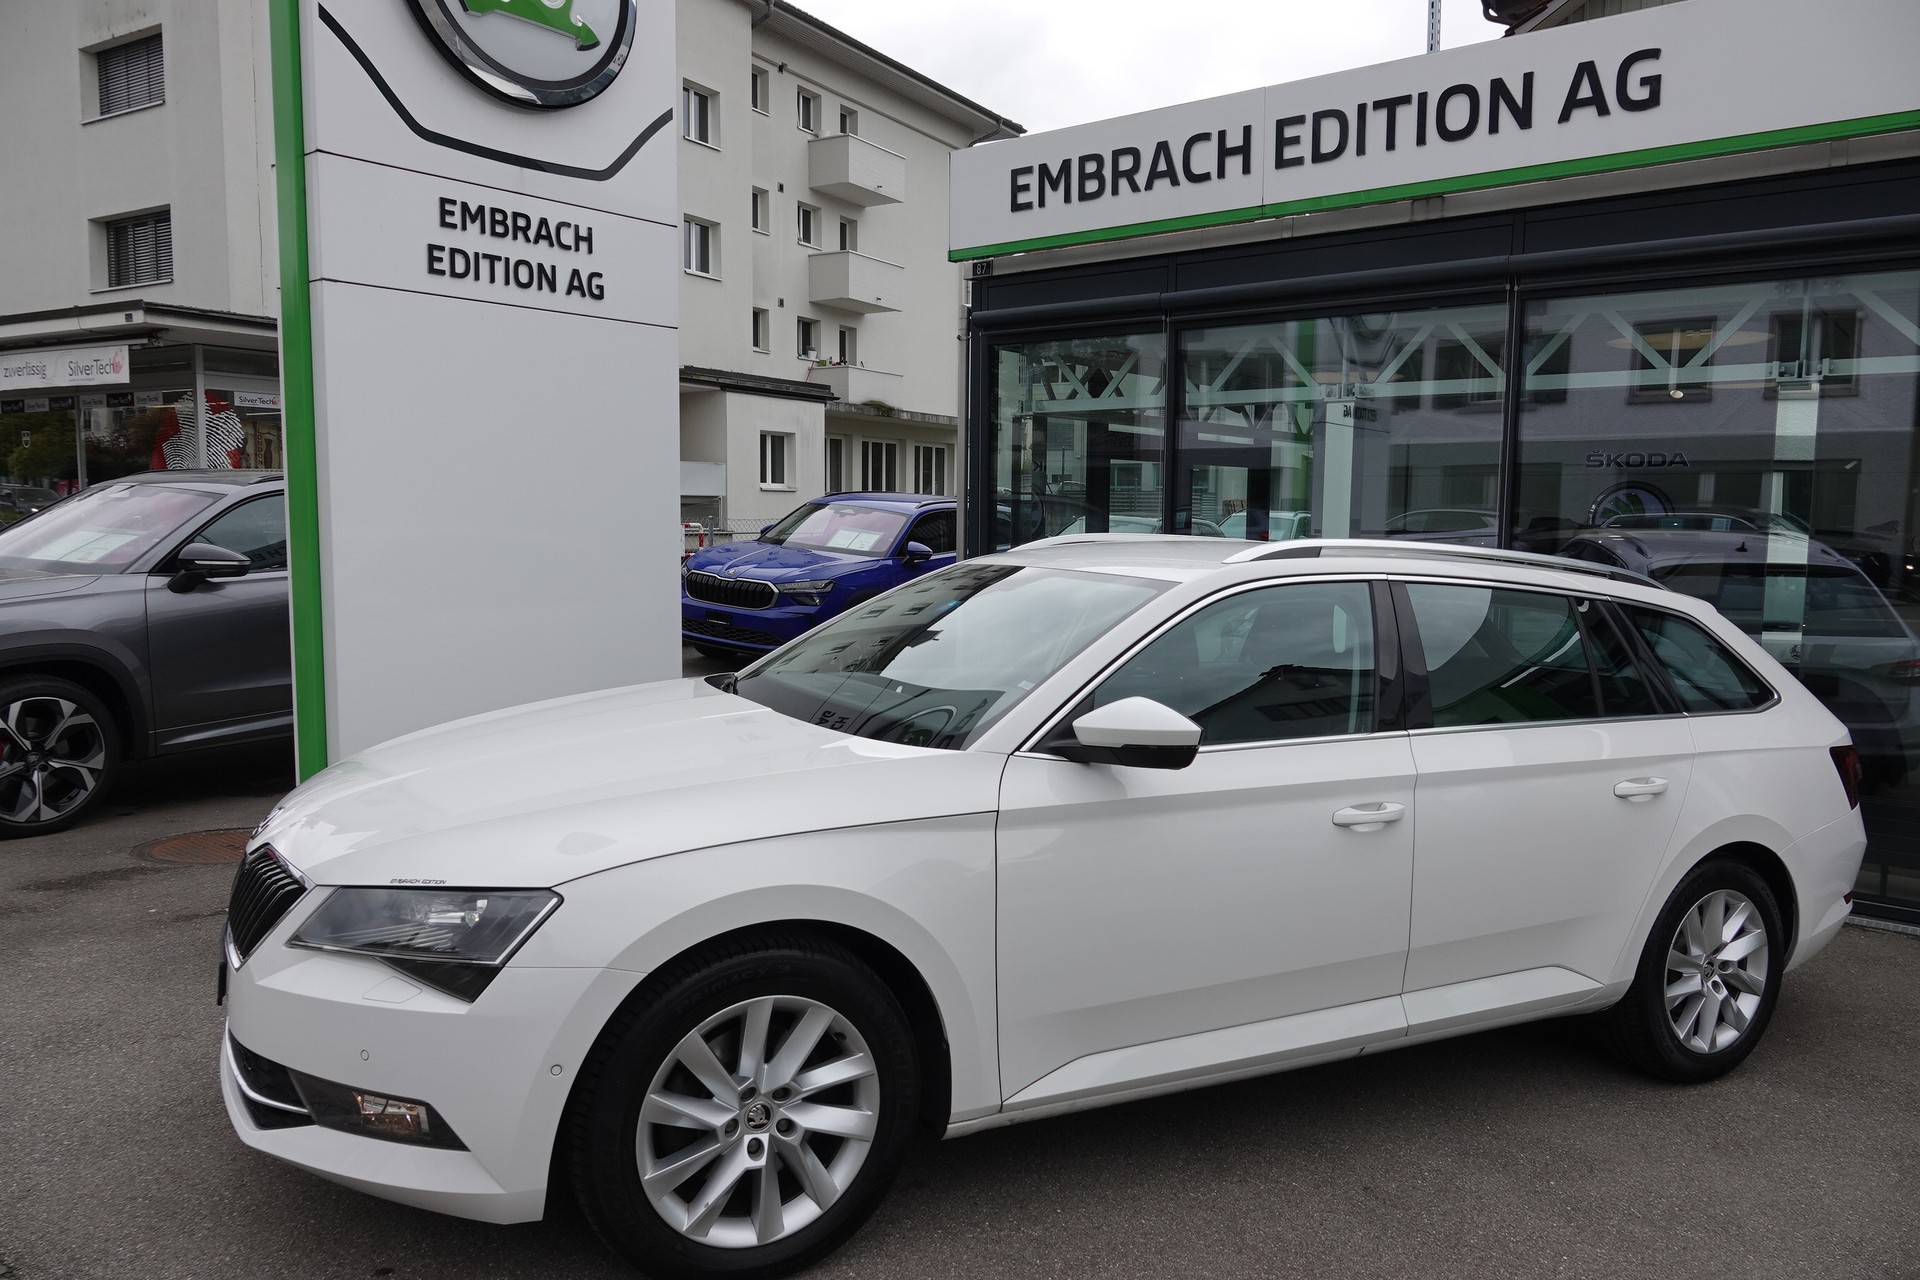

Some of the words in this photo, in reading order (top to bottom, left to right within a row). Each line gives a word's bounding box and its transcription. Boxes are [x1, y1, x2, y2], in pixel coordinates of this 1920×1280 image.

[1011, 124, 1252, 212] EMBRACH
[1275, 71, 1534, 170] EDITION
[1557, 47, 1663, 125] AG
[439, 196, 594, 254] EMBRACH
[426, 243, 557, 293] EDITION
[566, 268, 605, 301] AG
[976, 263, 987, 275] 87
[3, 360, 47, 380] zuverlässig
[1585, 449, 1691, 469] ŠKODA
